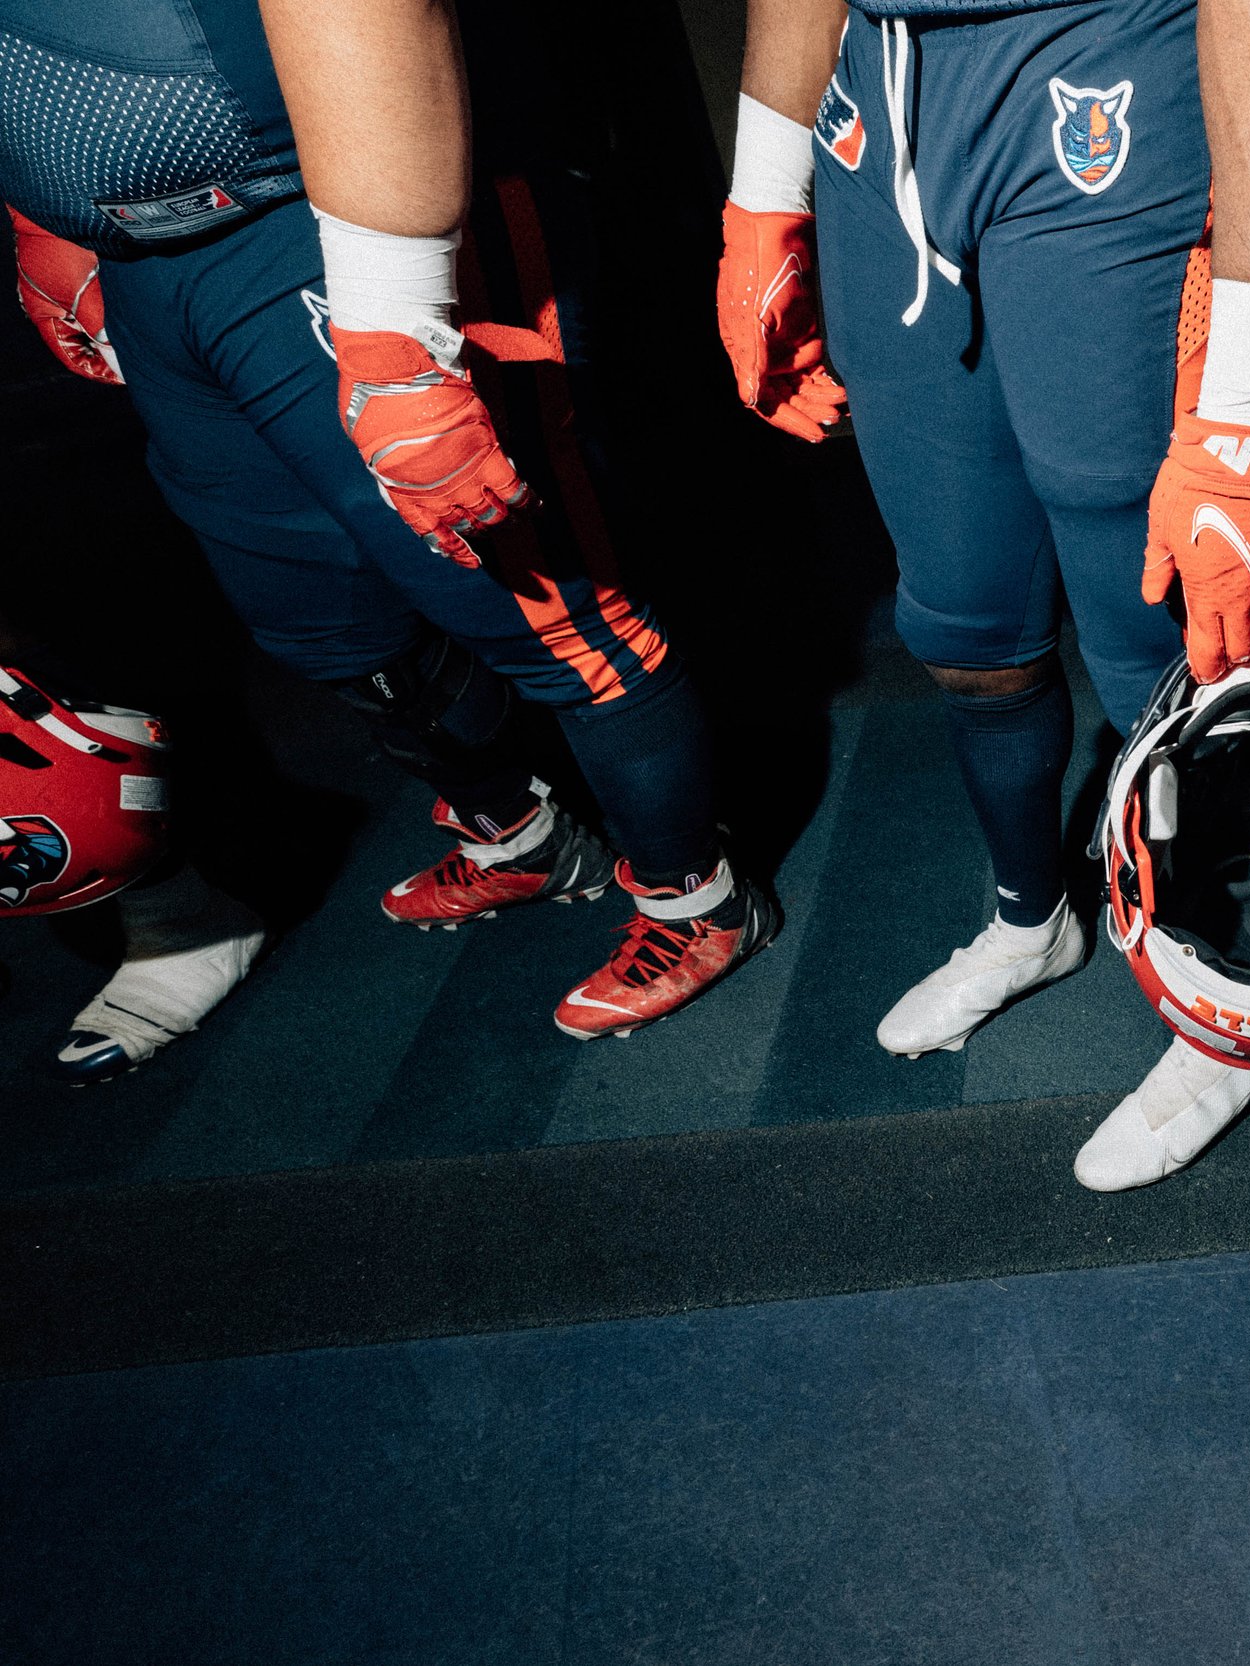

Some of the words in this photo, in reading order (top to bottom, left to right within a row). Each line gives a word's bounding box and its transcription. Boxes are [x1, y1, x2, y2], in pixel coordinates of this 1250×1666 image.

[171, 198, 200, 208] EUROPEAN
[138, 205, 160, 216] W
[180, 206, 206, 216] FOOTBALL
